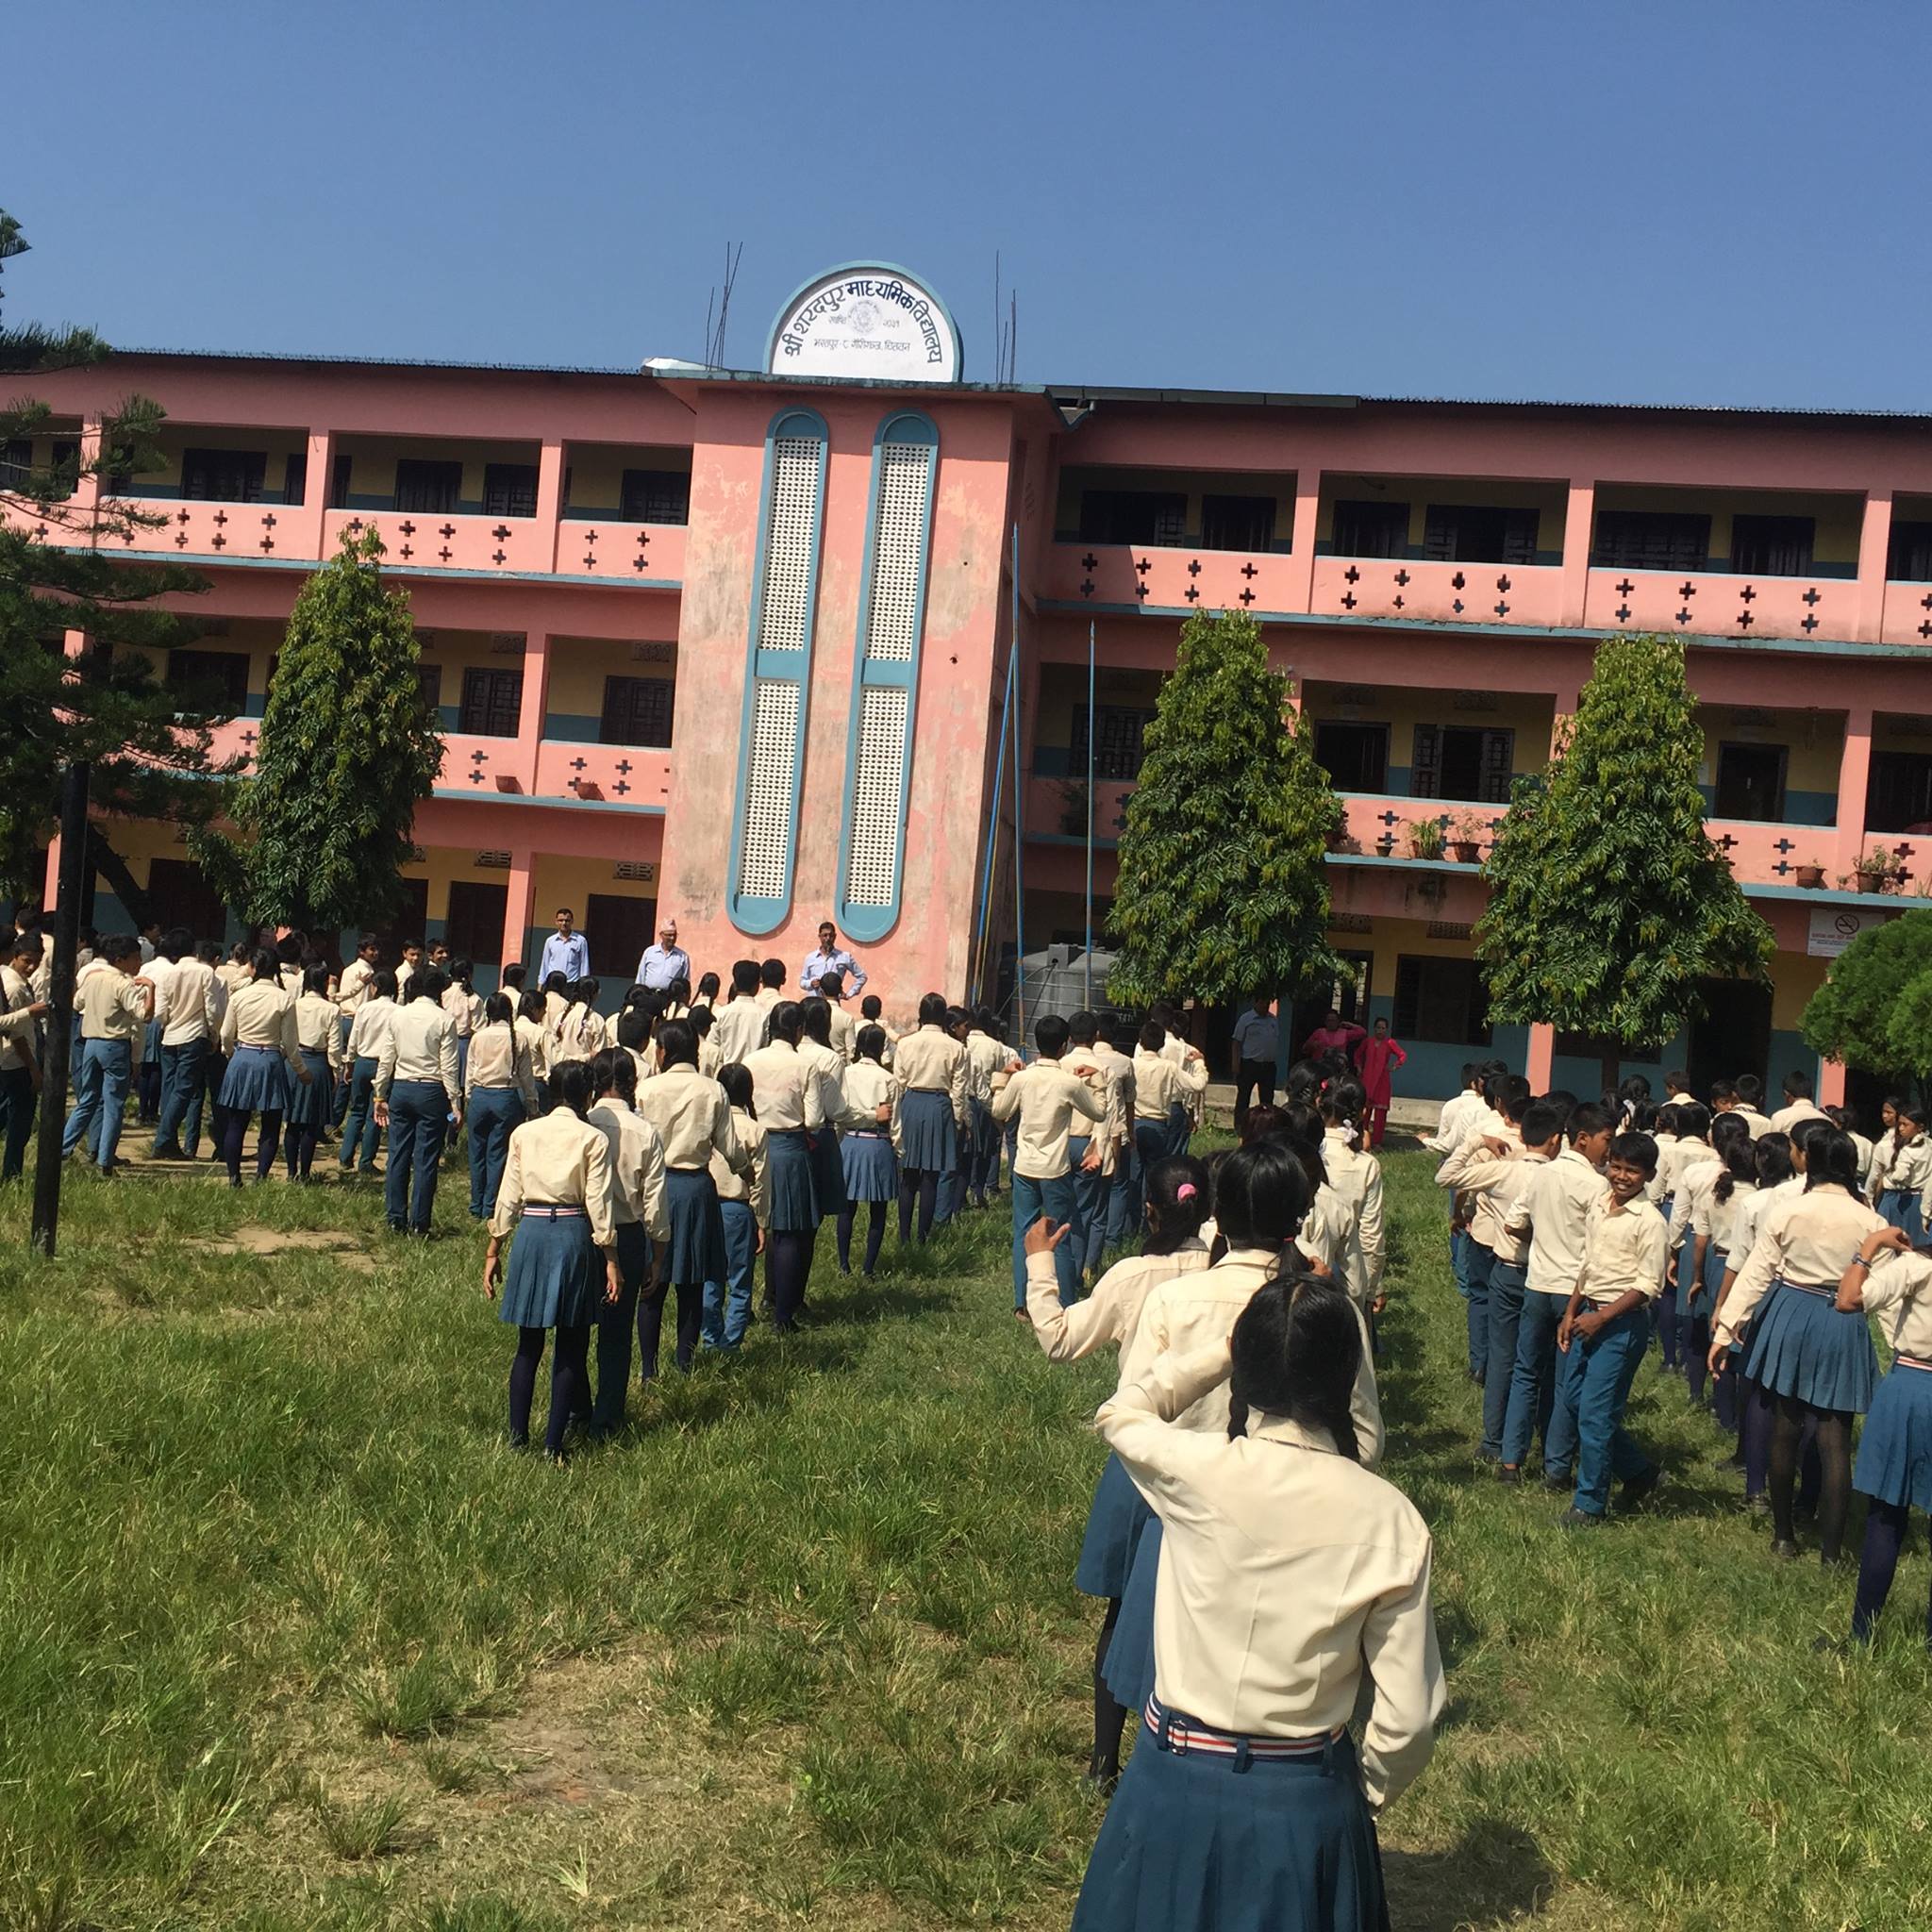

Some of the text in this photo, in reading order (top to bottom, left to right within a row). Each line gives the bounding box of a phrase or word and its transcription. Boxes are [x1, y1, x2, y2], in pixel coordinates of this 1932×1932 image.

[781, 279, 942, 363] श्री शरदपुर माध्यमिक विद्यालय
